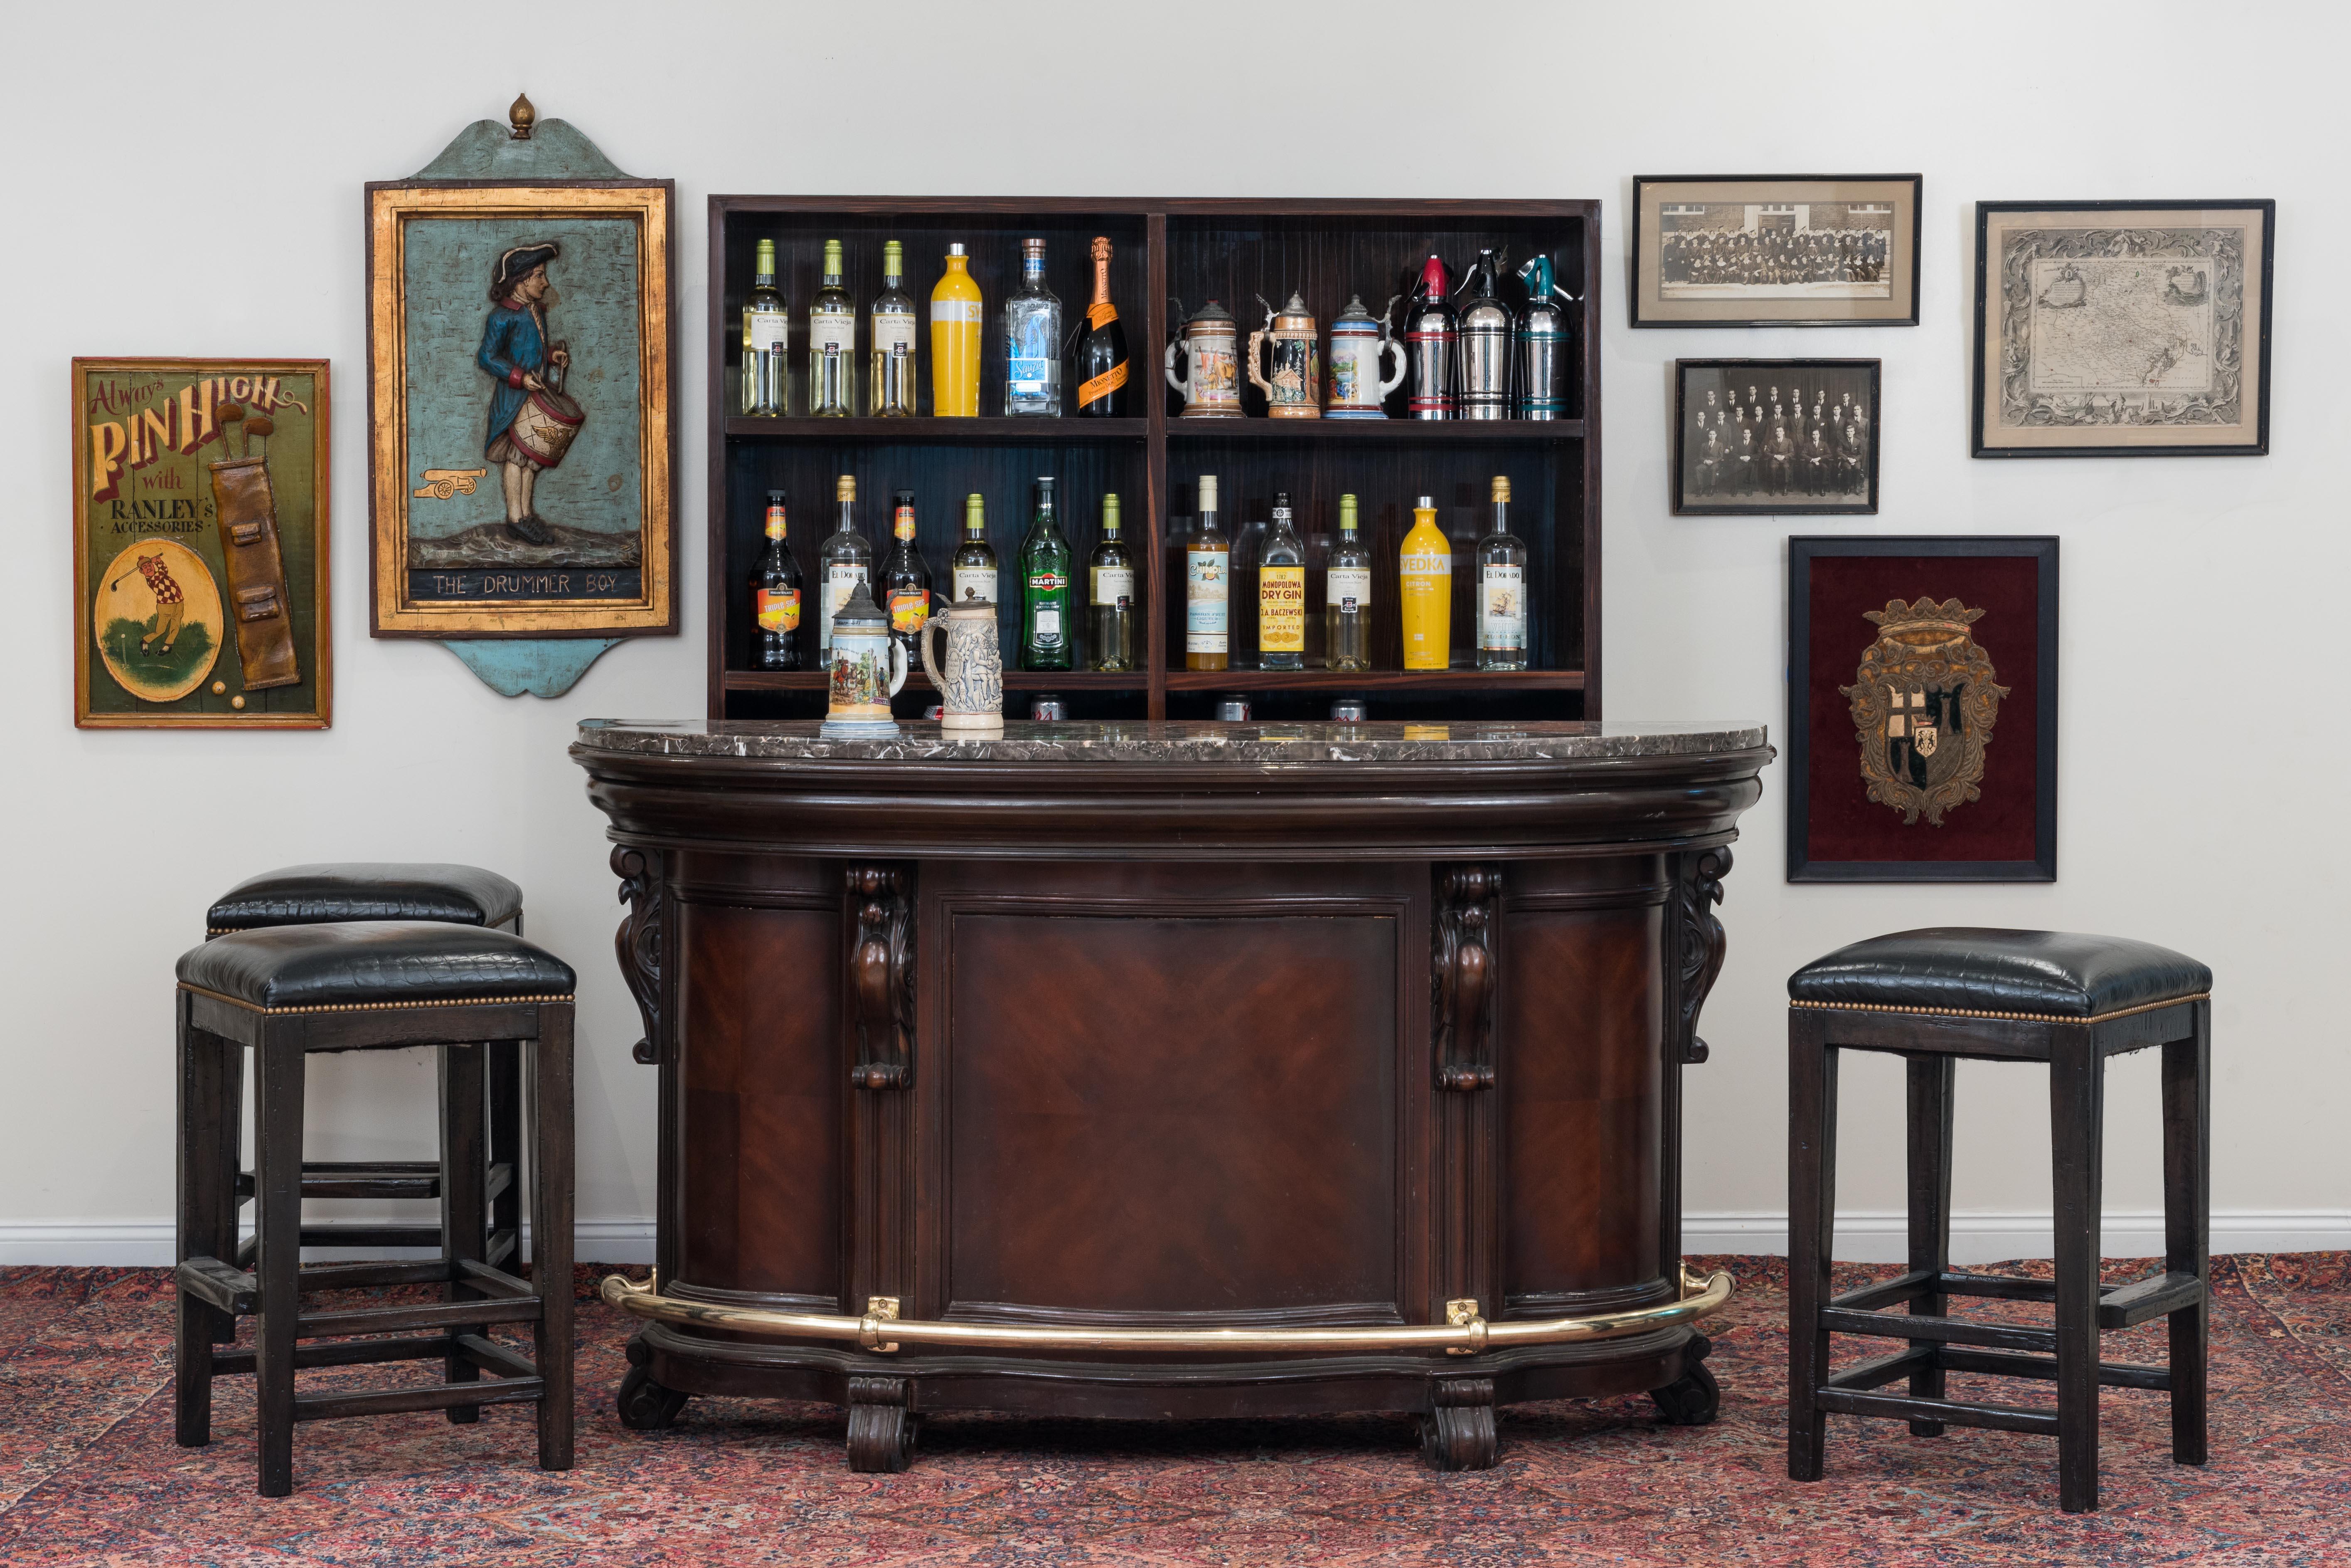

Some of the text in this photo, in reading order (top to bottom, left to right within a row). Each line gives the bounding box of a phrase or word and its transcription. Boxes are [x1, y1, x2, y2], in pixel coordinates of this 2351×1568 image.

[1014, 360, 1044, 379] Sauza
[1090, 367, 1122, 389] MIONETTO
[91, 379, 164, 415] Always
[90, 376, 287, 504] PIN HIGH
[143, 467, 185, 490] with
[111, 520, 204, 534] ACCESSORIES
[1189, 564, 1227, 576] CHINOLA
[433, 574, 619, 594] THE DRUMMER BOY
[1262, 590, 1301, 599] DRY GIN
[1491, 623, 1515, 631] WHITE
